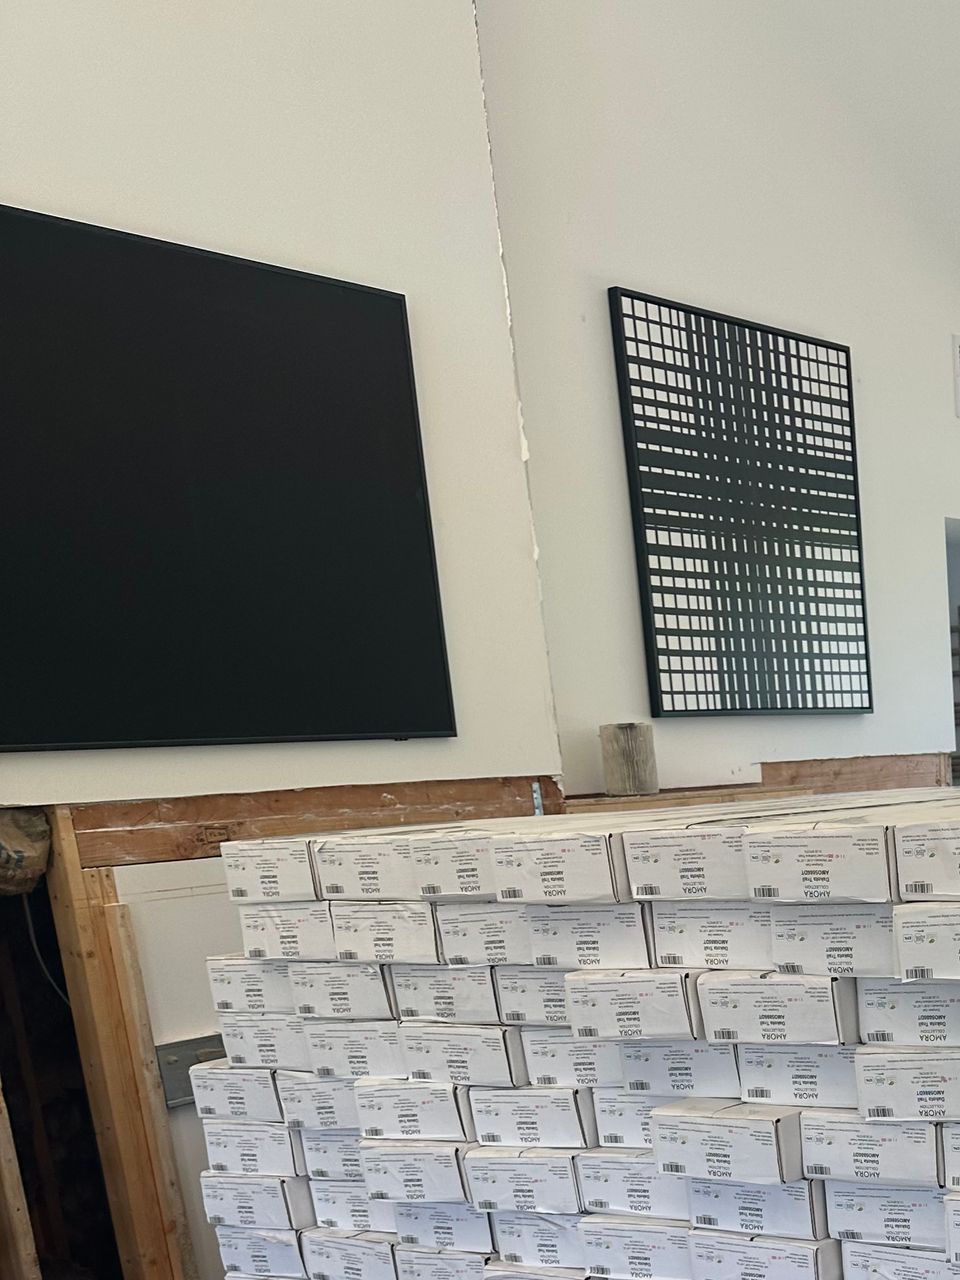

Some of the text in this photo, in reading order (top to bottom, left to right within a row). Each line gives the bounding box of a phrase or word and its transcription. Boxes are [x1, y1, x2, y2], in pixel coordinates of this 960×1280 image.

[543, 888, 566, 897] AMORA
[682, 886, 707, 894] AMORA
[803, 890, 830, 898] AMORA
[854, 1170, 880, 1178] AMORA
